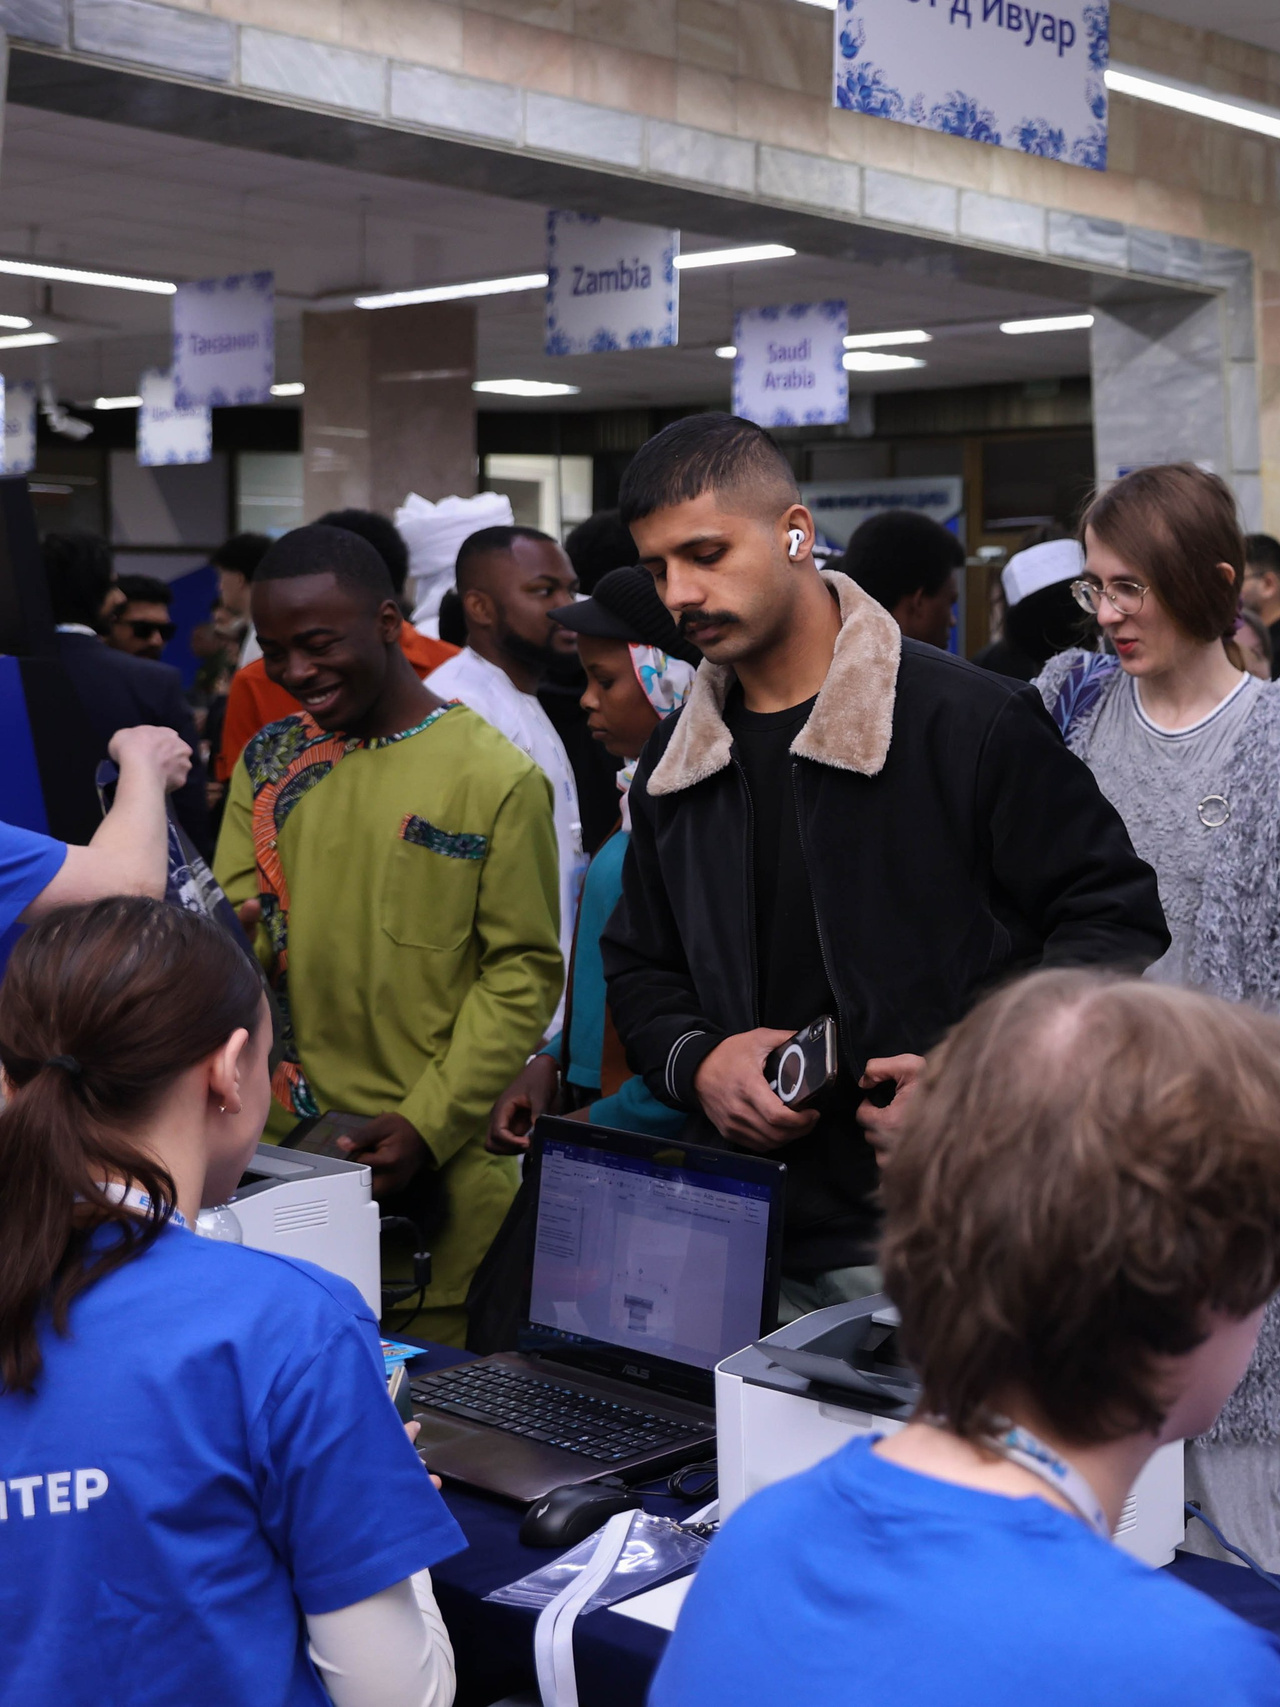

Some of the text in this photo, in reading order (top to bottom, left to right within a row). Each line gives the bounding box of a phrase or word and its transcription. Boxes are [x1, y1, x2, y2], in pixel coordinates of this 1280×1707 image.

[572, 257, 651, 297] Zambia
[768, 338, 812, 363] Saudi
[763, 369, 816, 391] Arabia
[622, 1364, 650, 1379] ASUS
